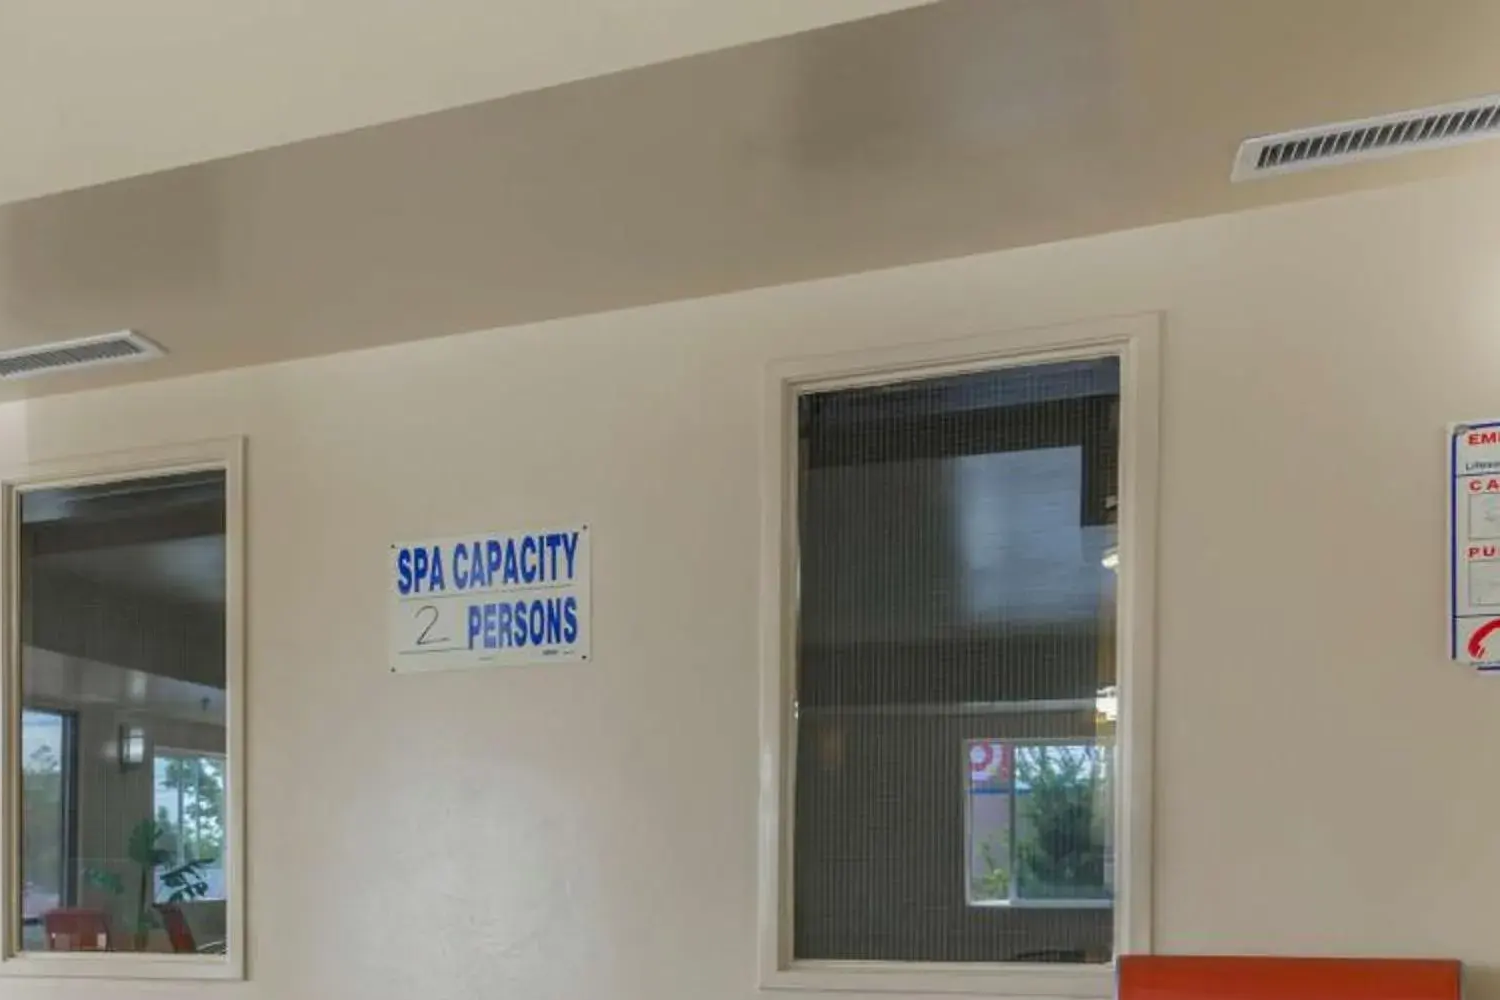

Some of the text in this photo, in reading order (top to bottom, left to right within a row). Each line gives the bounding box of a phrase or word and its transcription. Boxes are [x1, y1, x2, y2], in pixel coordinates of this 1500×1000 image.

[1467, 431, 1500, 446] EM
[397, 531, 579, 595] SPA CAPACITY
[415, 597, 578, 650] 2 PERSONS
